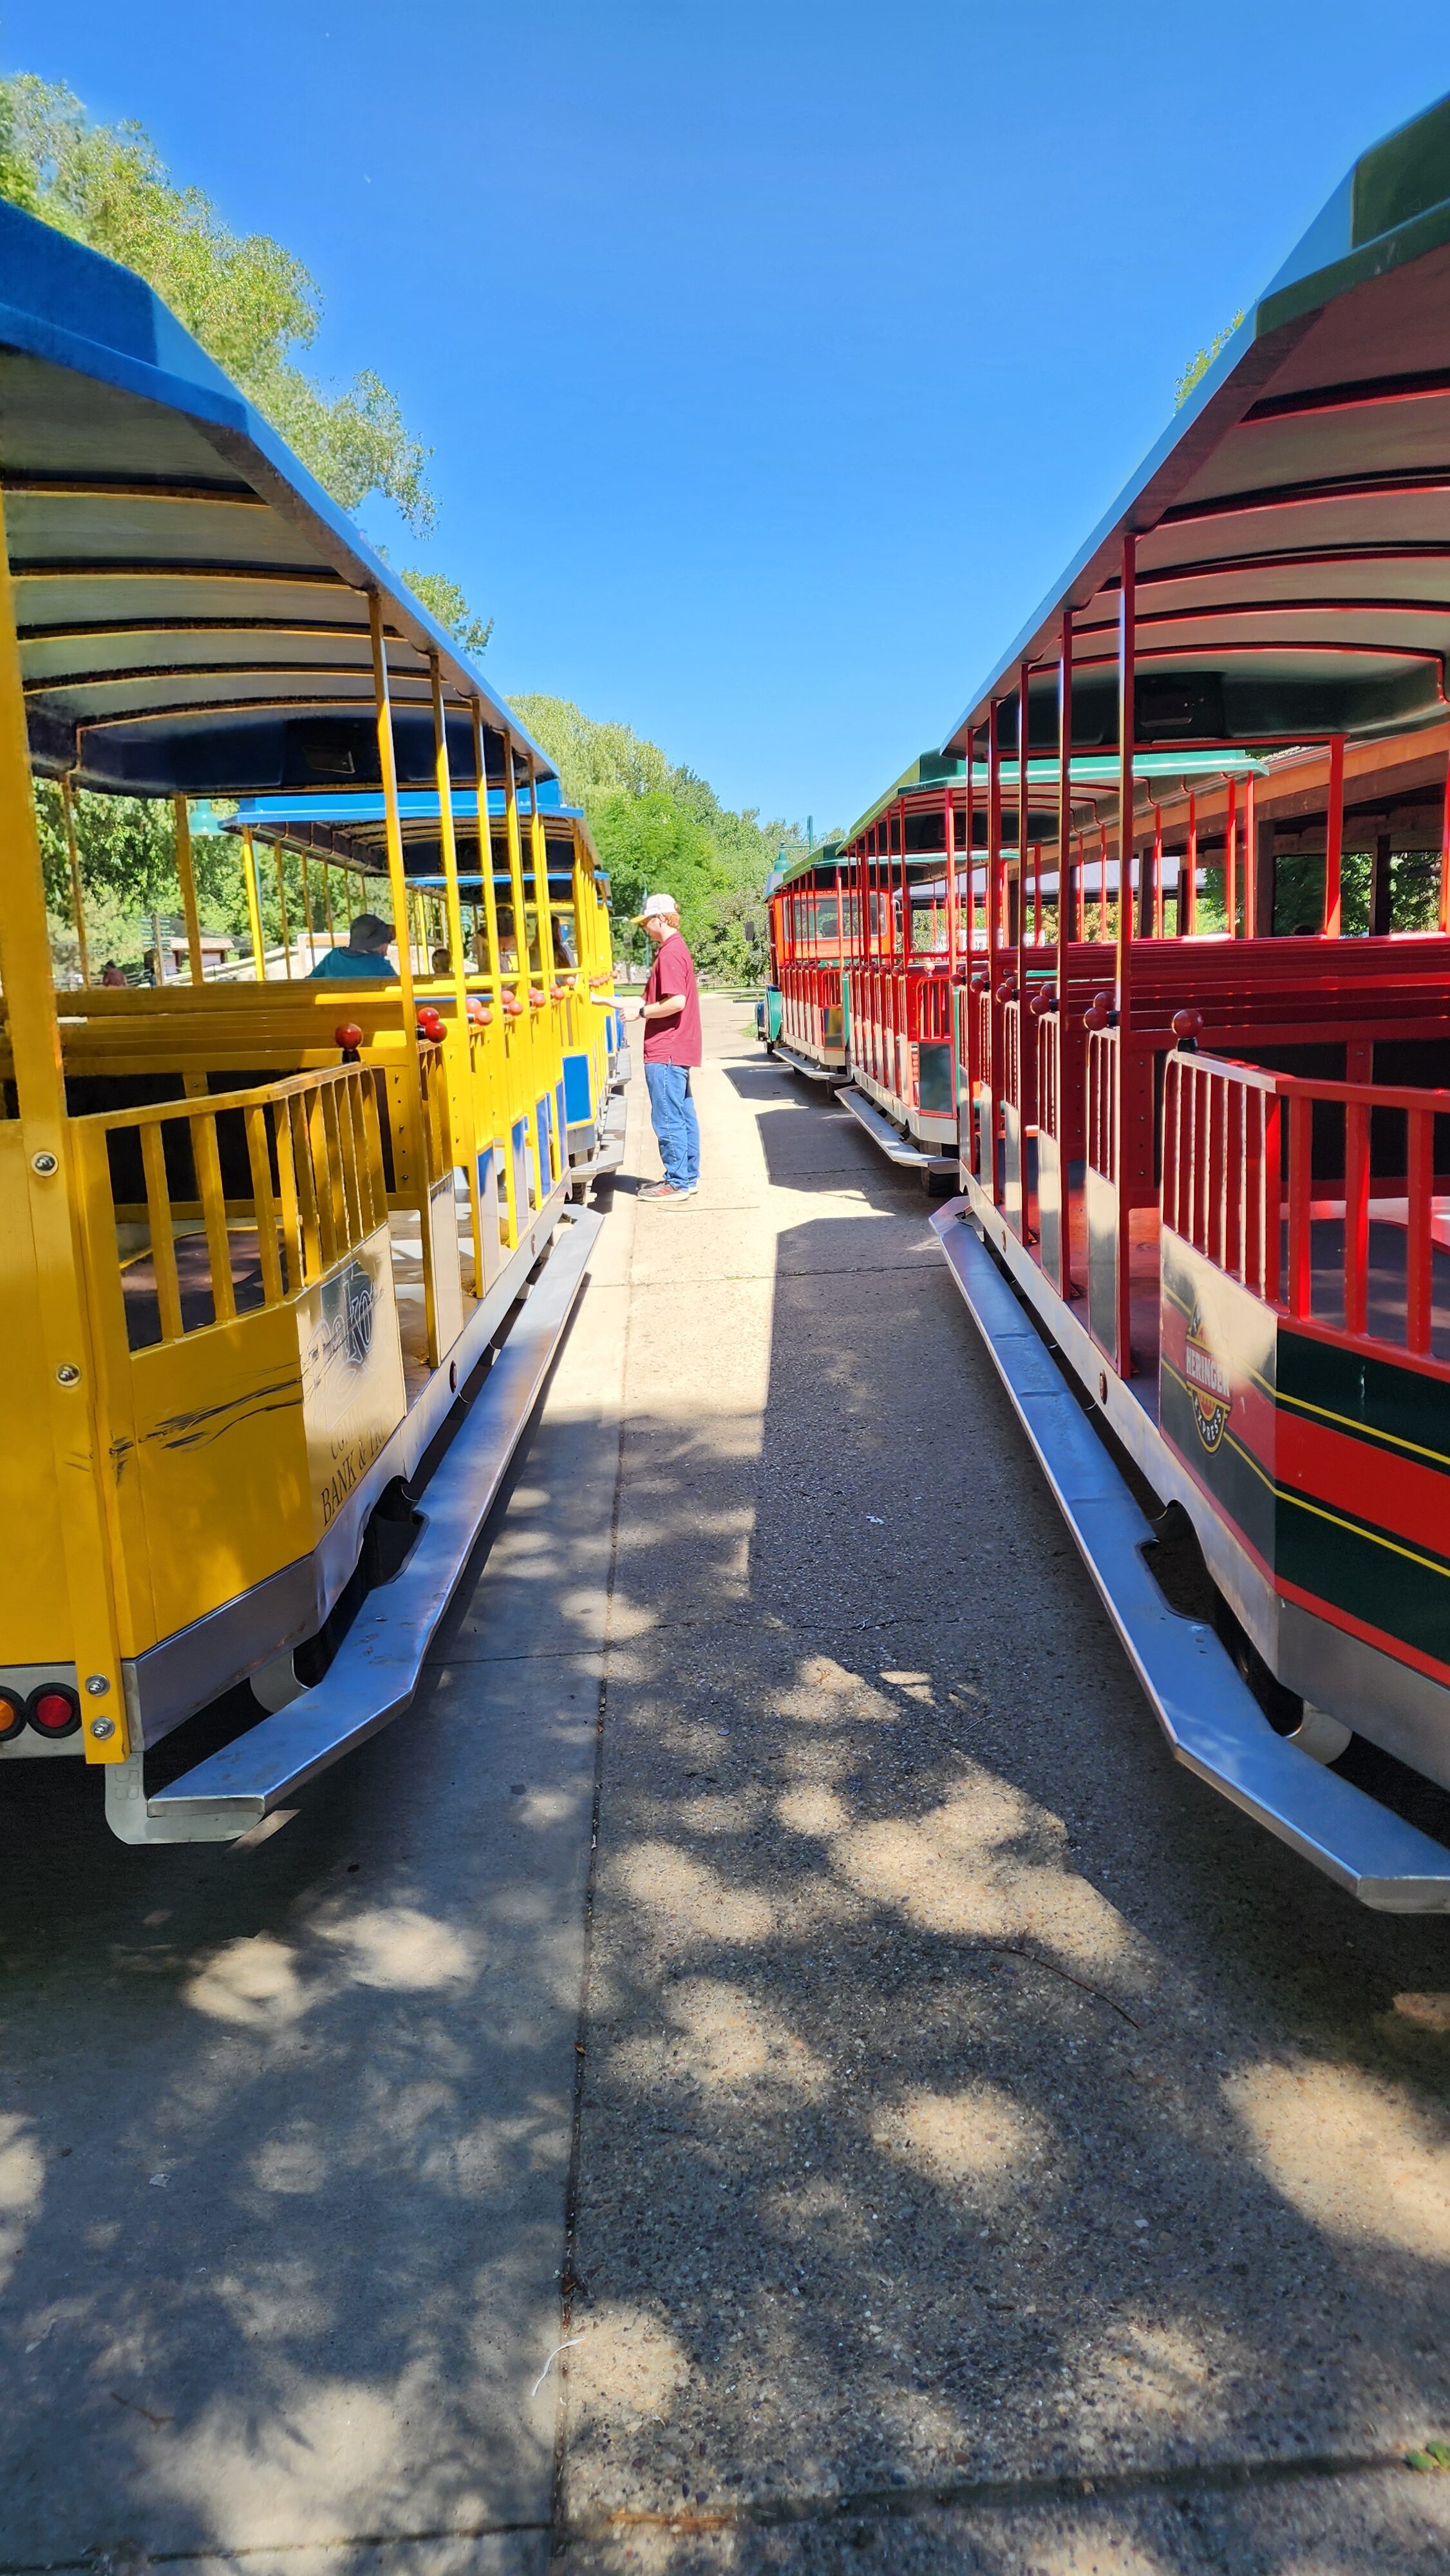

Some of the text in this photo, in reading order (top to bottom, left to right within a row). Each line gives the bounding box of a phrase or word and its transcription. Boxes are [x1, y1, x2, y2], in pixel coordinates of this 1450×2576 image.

[1194, 1396, 1221, 1442] EXPRESS
[321, 1450, 357, 1527] BANK
[358, 1437, 367, 1471] &
